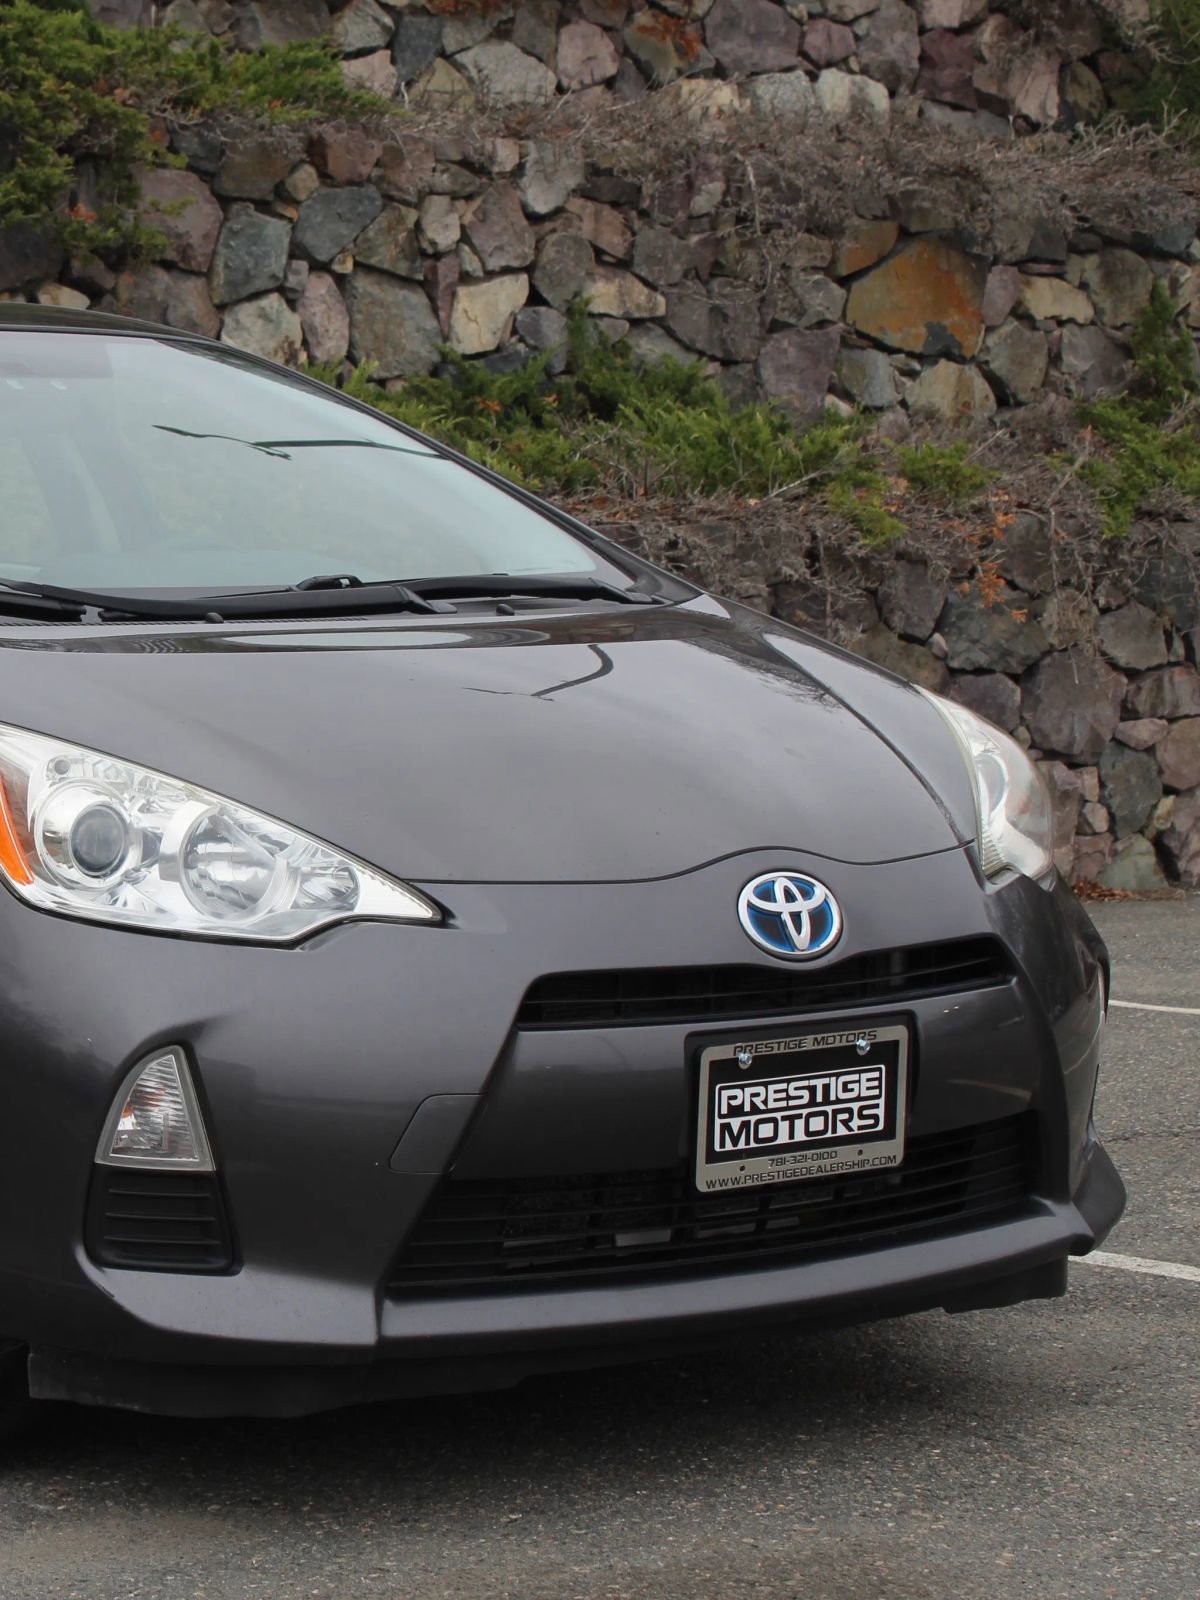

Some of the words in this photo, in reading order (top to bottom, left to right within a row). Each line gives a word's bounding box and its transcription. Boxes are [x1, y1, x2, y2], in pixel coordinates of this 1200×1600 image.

[733, 1038, 808, 1056] PRESTIGE
[812, 1030, 877, 1047] MOTORS
[720, 1071, 880, 1115] PRESTIGE
[719, 1102, 880, 1150] MOTORS
[705, 1154, 897, 1190] WWW.PRESTIGEDEALERSHIP.COM
[768, 1150, 838, 1168] 781-321-0100
